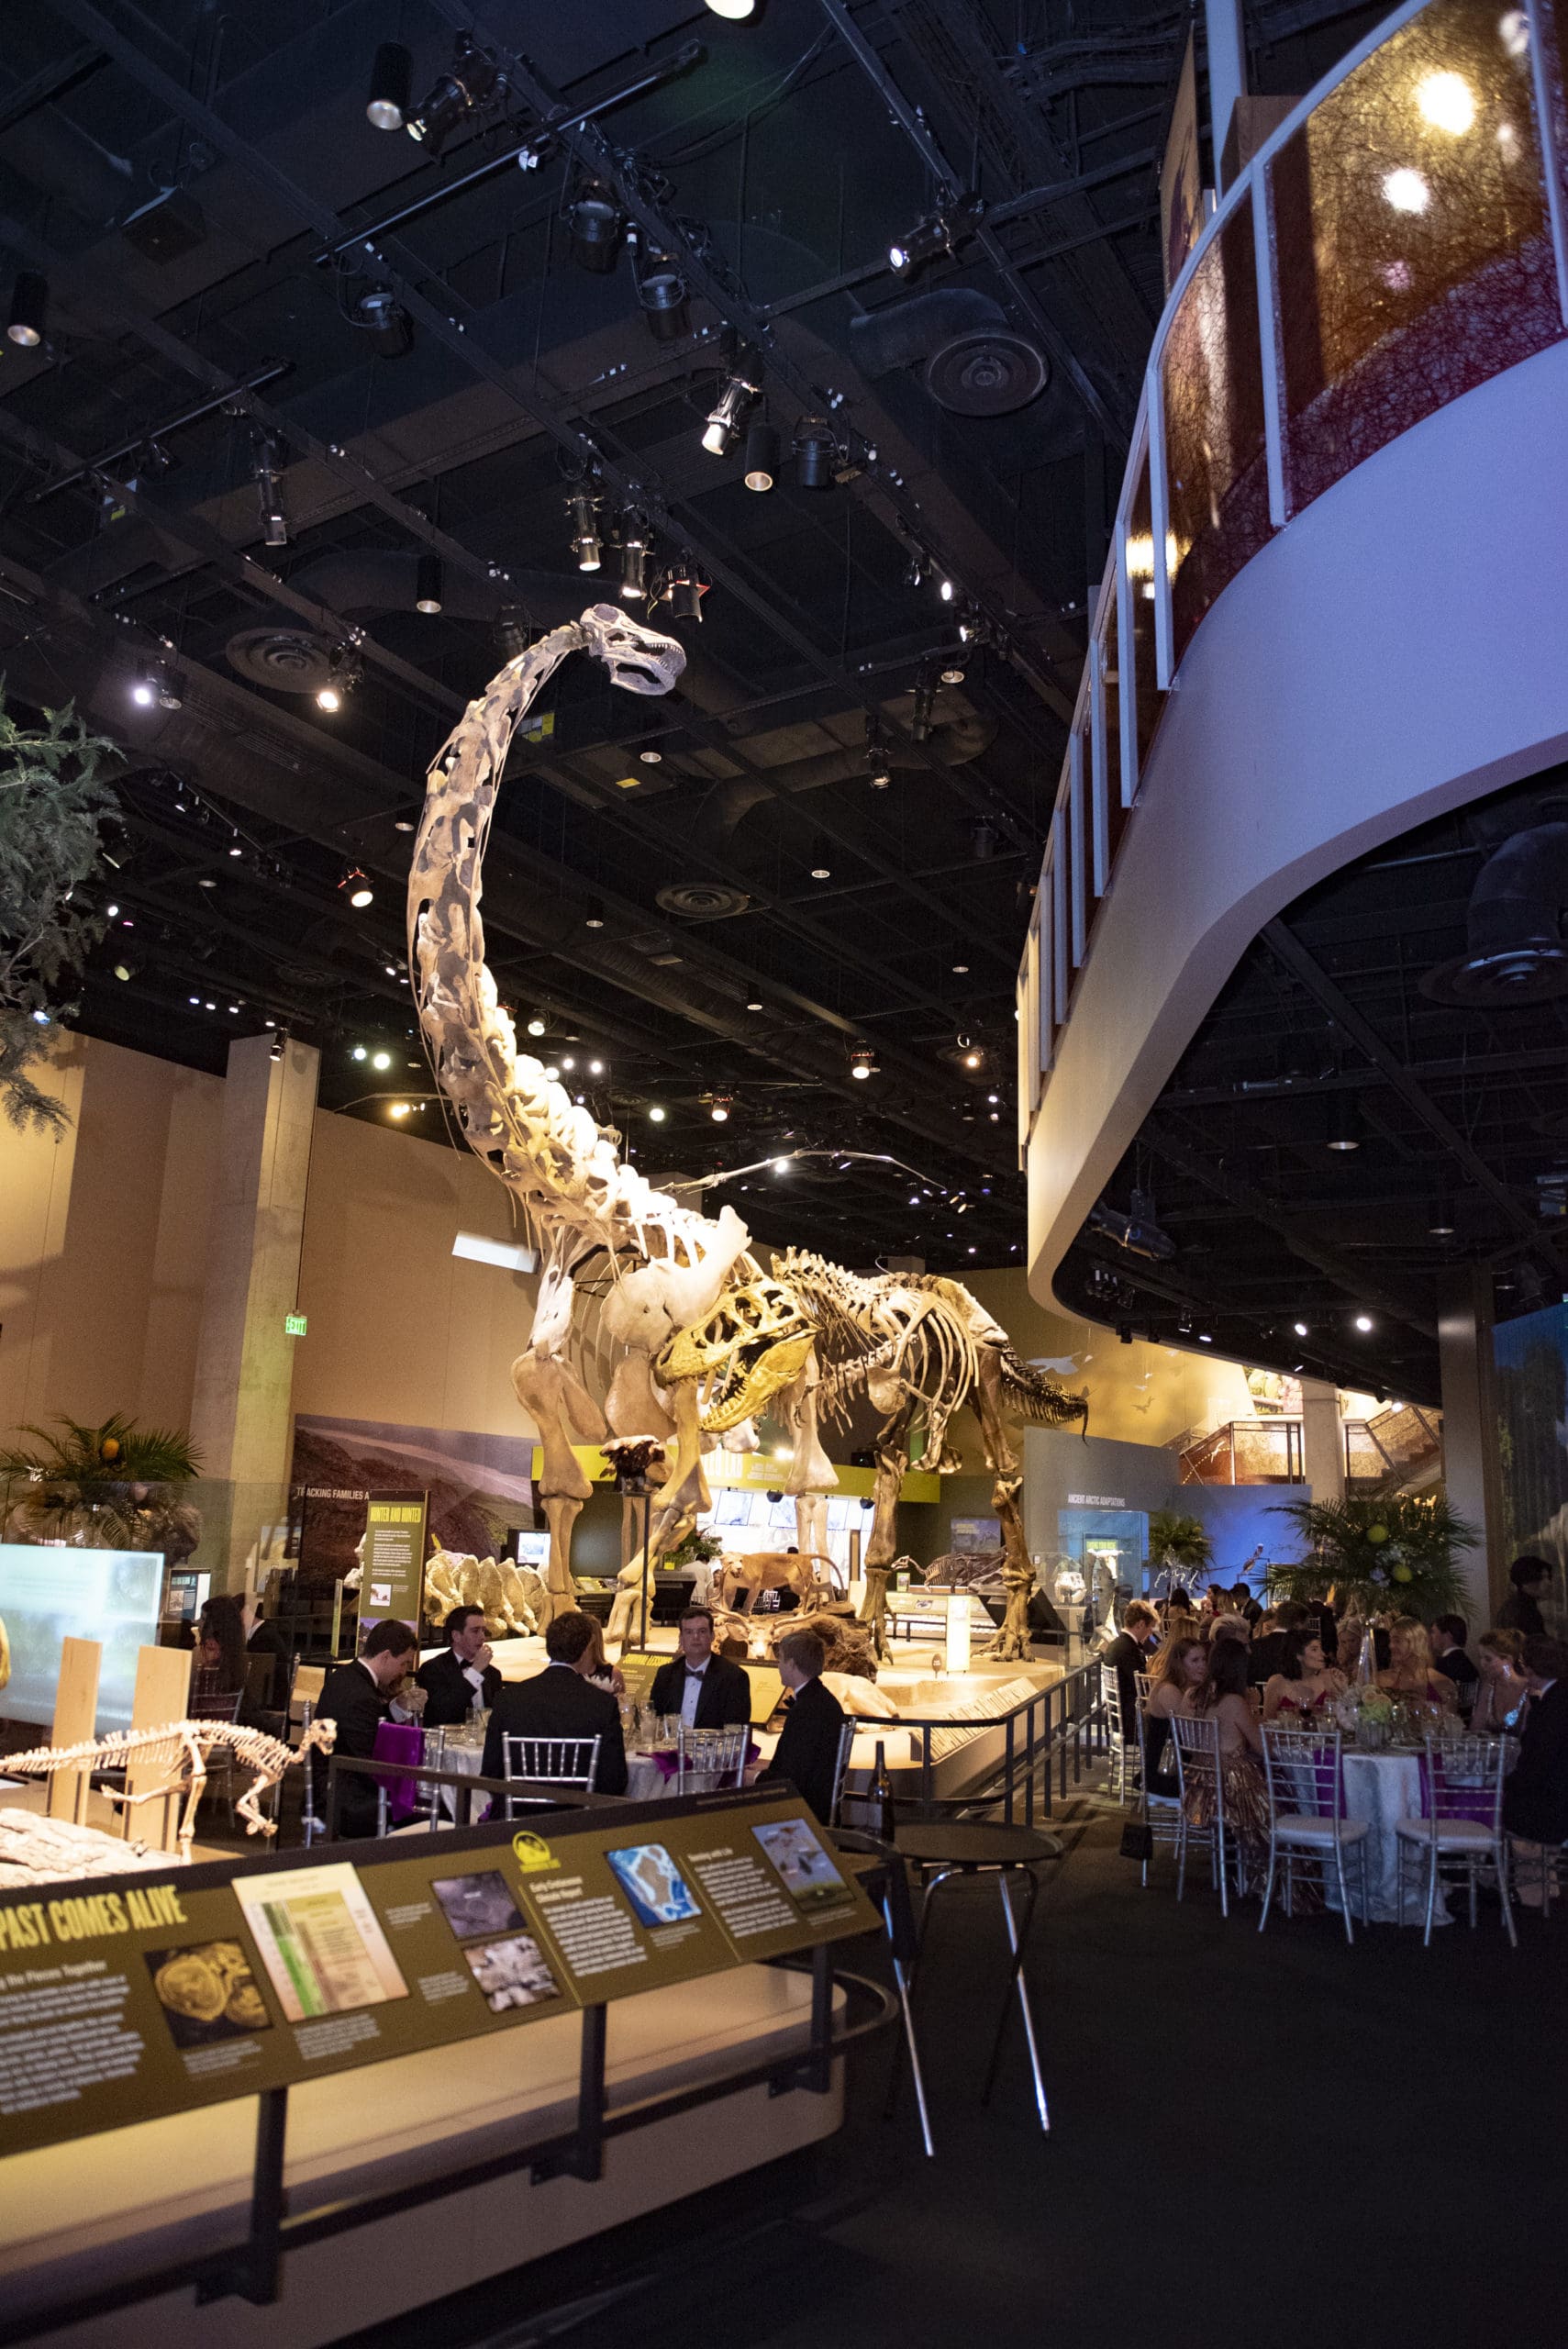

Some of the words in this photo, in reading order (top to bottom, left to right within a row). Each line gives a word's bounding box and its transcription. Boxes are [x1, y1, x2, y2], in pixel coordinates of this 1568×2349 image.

[296, 1486, 331, 1498] TRACKING
[333, 1488, 362, 1500] FAMILIES
[390, 1507, 401, 1522] AND
[0, 1903, 50, 1951] PAST
[49, 1892, 129, 1943] COMES
[125, 1885, 188, 1930] ALIVE
